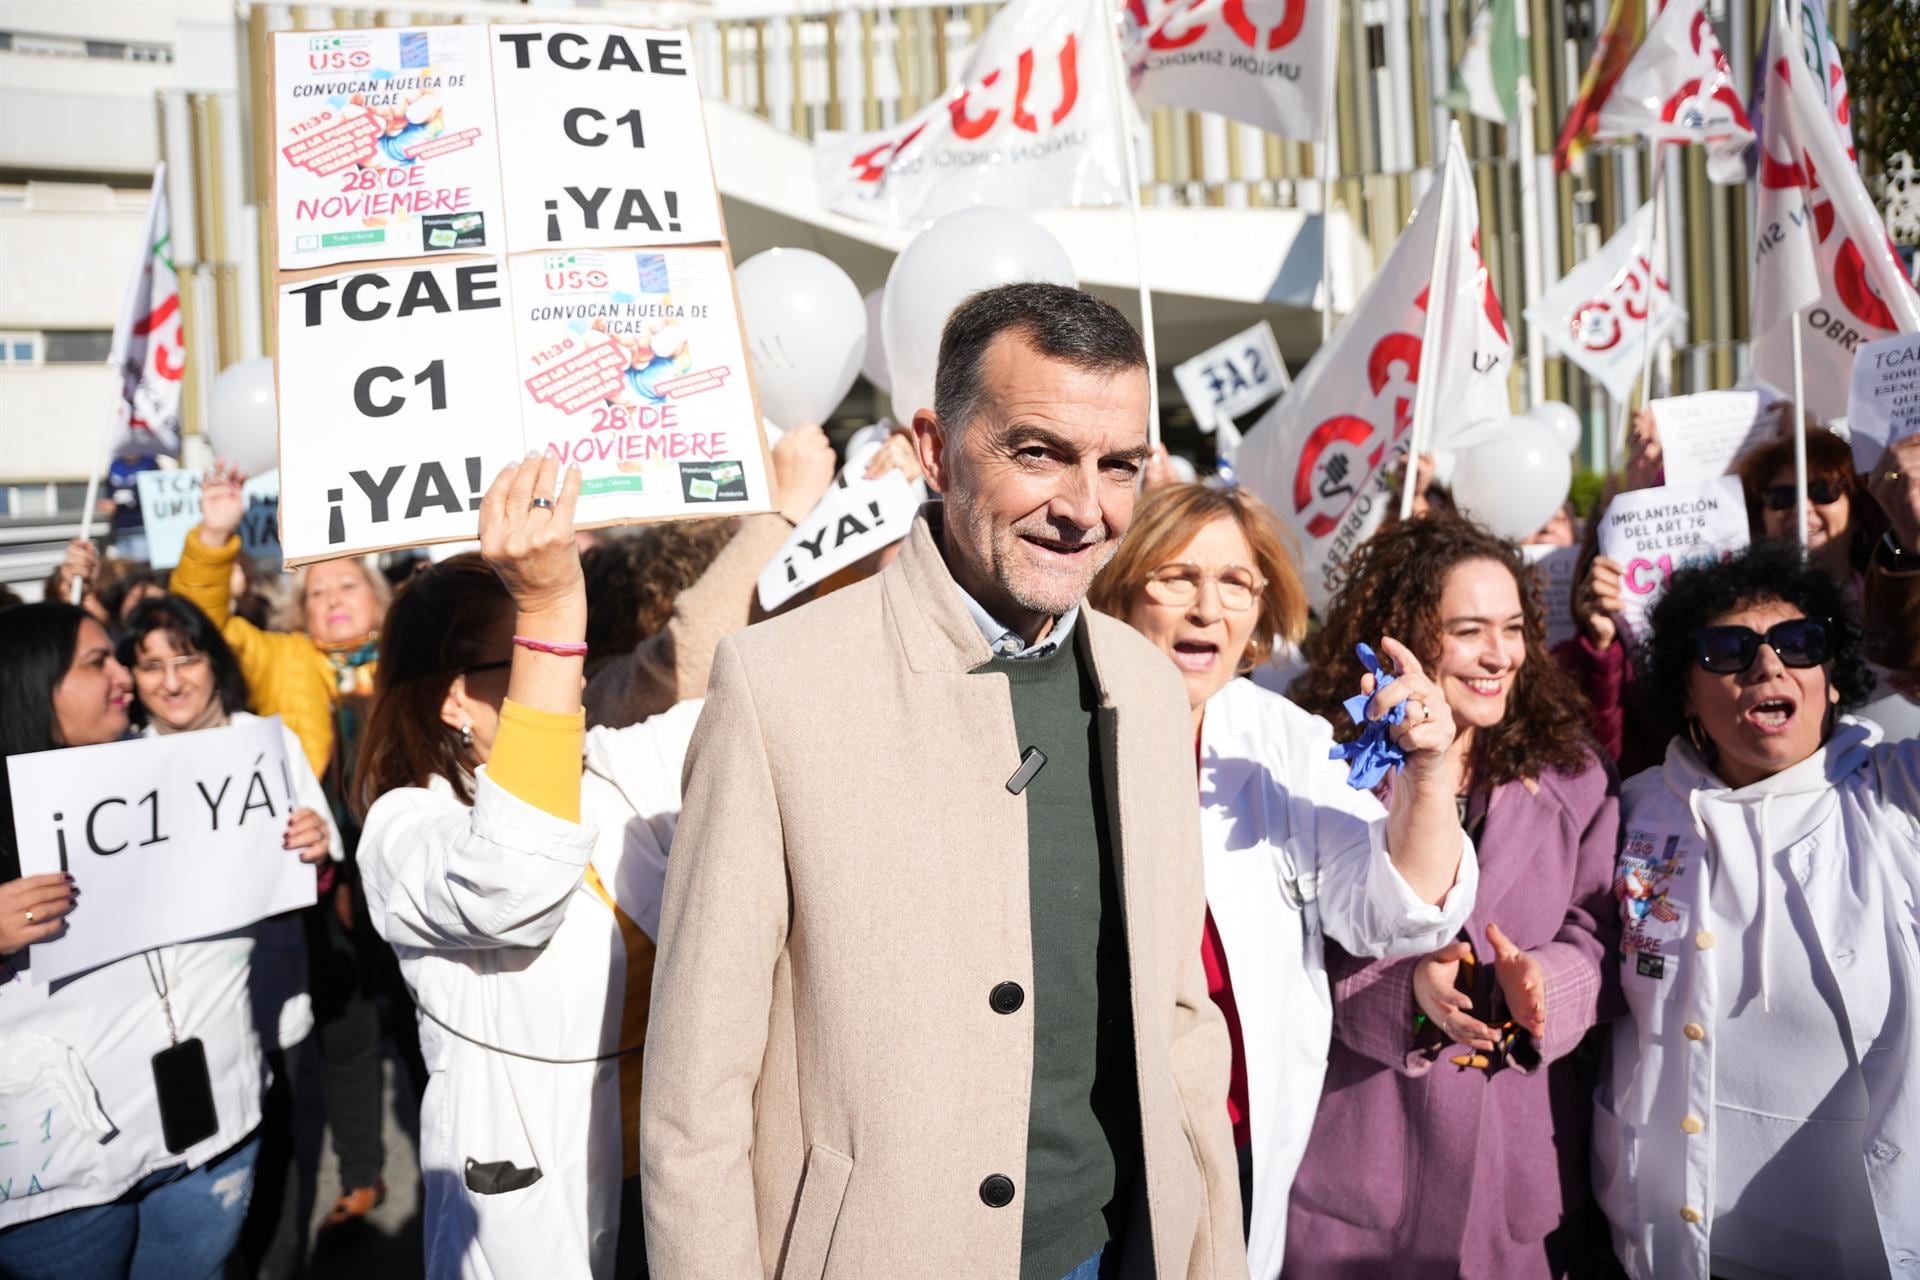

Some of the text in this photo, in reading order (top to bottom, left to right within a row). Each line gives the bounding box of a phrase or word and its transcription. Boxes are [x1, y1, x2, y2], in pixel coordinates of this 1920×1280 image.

[310, 51, 370, 69] USO
[499, 31, 688, 76] TCAE
[293, 75, 467, 98] CONVOCAN HUELGA DE
[364, 93, 399, 107] TCAE
[290, 112, 332, 135] 11:30
[563, 107, 646, 149] C1
[341, 165, 425, 193] 28 DE
[296, 186, 472, 221] NOVIEMBRE
[545, 187, 683, 242] ¡YA!
[545, 270, 608, 290] USO
[287, 264, 502, 327] TCAE
[531, 303, 709, 321] CONVOCAN HUELGA DE
[606, 320, 642, 334] TCAE
[531, 338, 574, 366] 11:30
[353, 359, 447, 418] C1
[591, 405, 678, 432] 28 DE
[548, 432, 728, 465] NOVIEMBRE
[327, 456, 483, 545] ¡YA!
[1612, 498, 1718, 526] IMPLANTACIÓN
[1625, 516, 1706, 538] DEL ART 76
[784, 501, 885, 583] ¡YA!
[1637, 538, 1661, 552] DEL
[1625, 553, 1673, 595] C1
[52, 752, 296, 872] ¡C1 YÁ!
